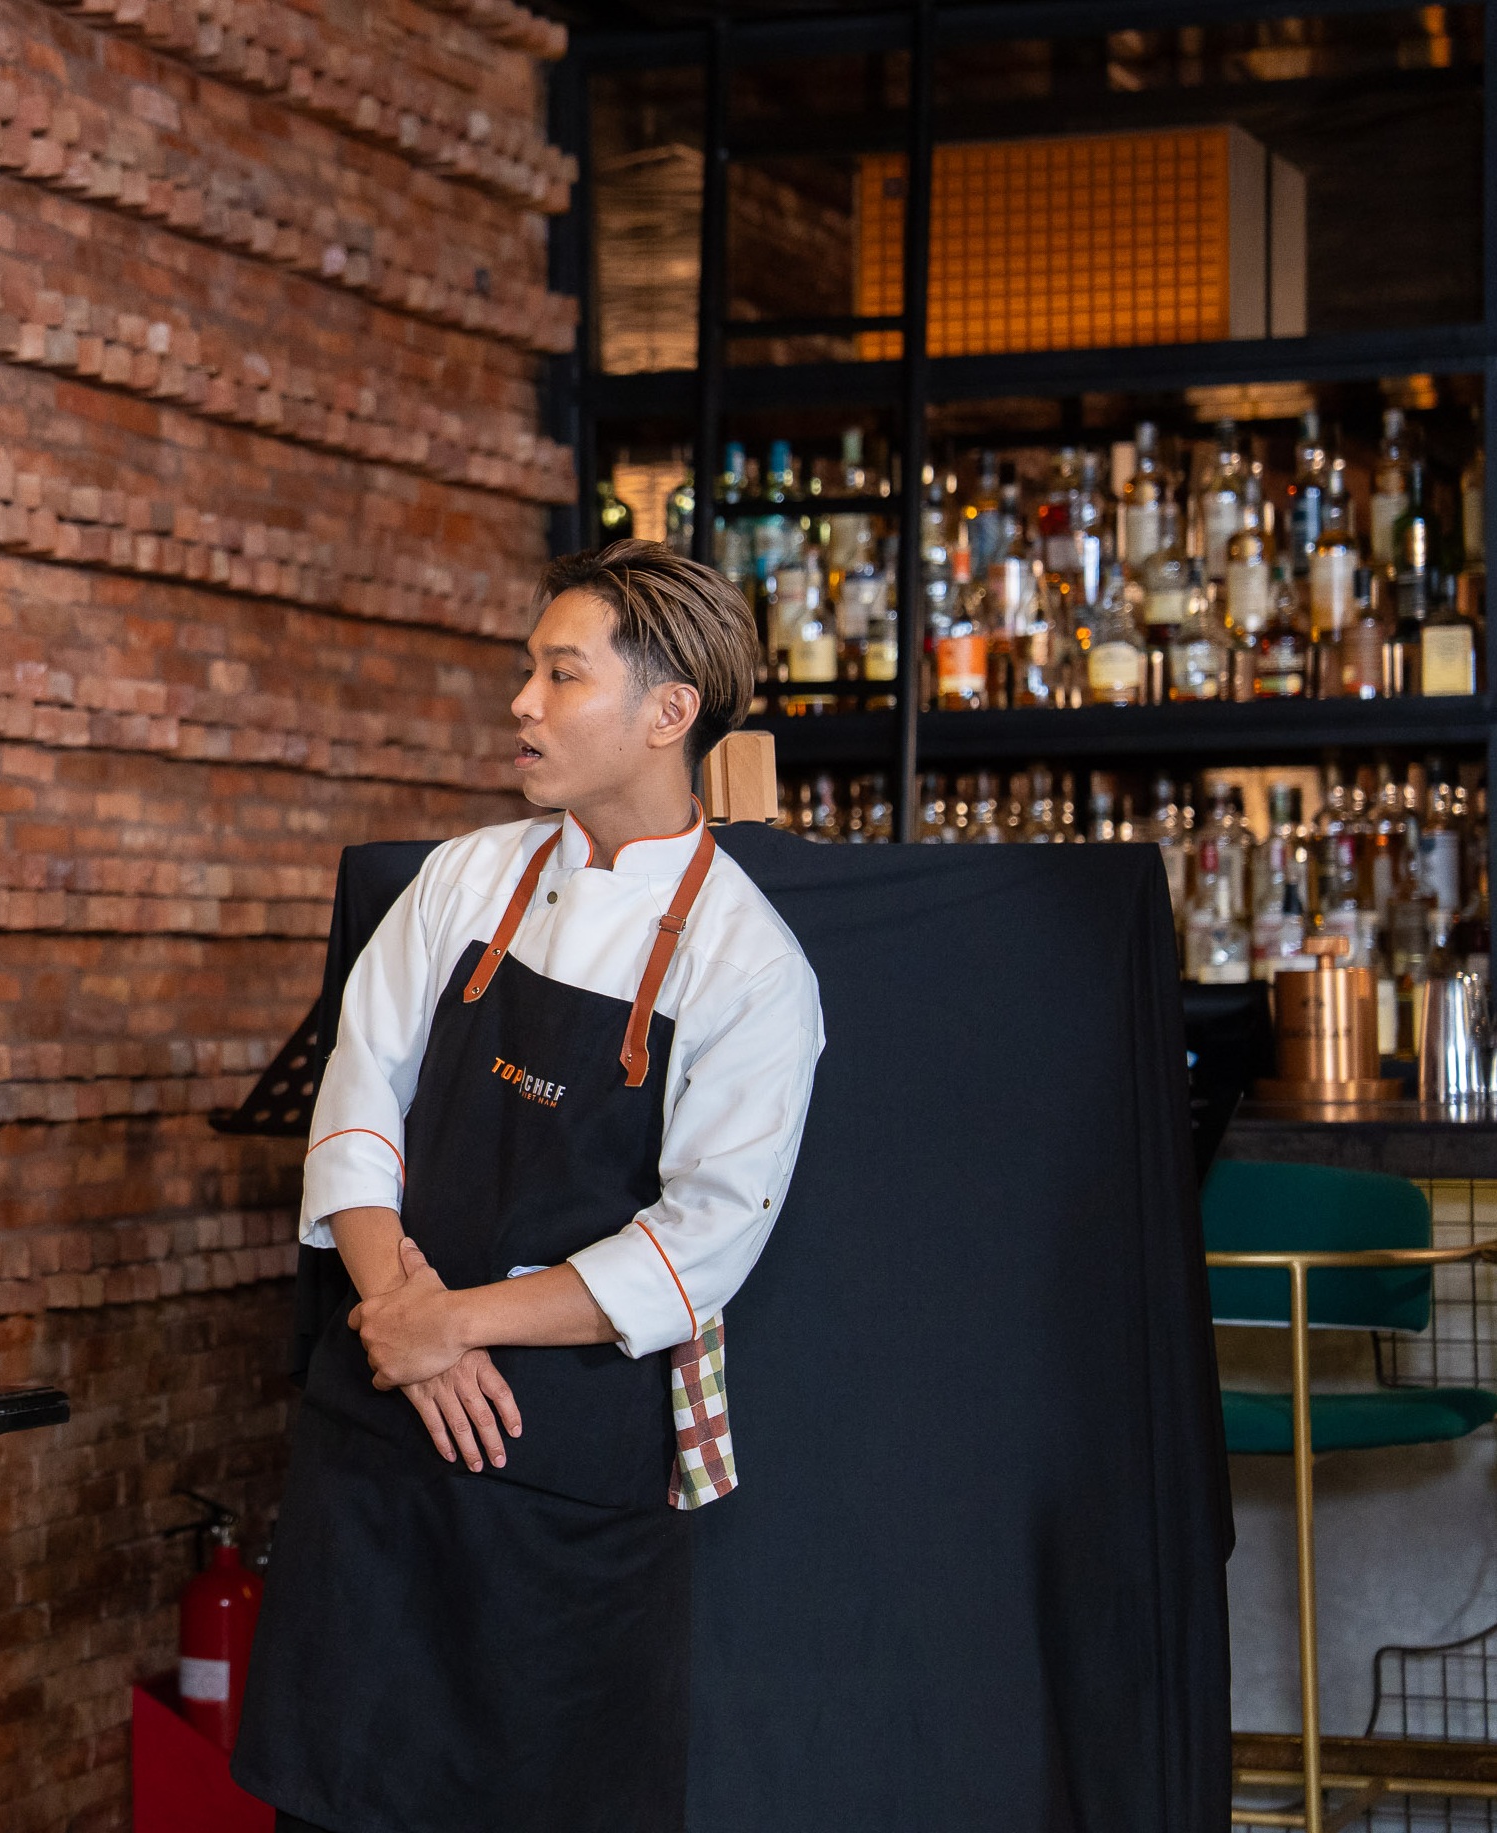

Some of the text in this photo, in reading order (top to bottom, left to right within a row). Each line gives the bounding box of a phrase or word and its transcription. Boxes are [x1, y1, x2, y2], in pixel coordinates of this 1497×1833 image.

[491, 1057, 566, 1101] TOP CHEF
[537, 1097, 558, 1108] NAM
